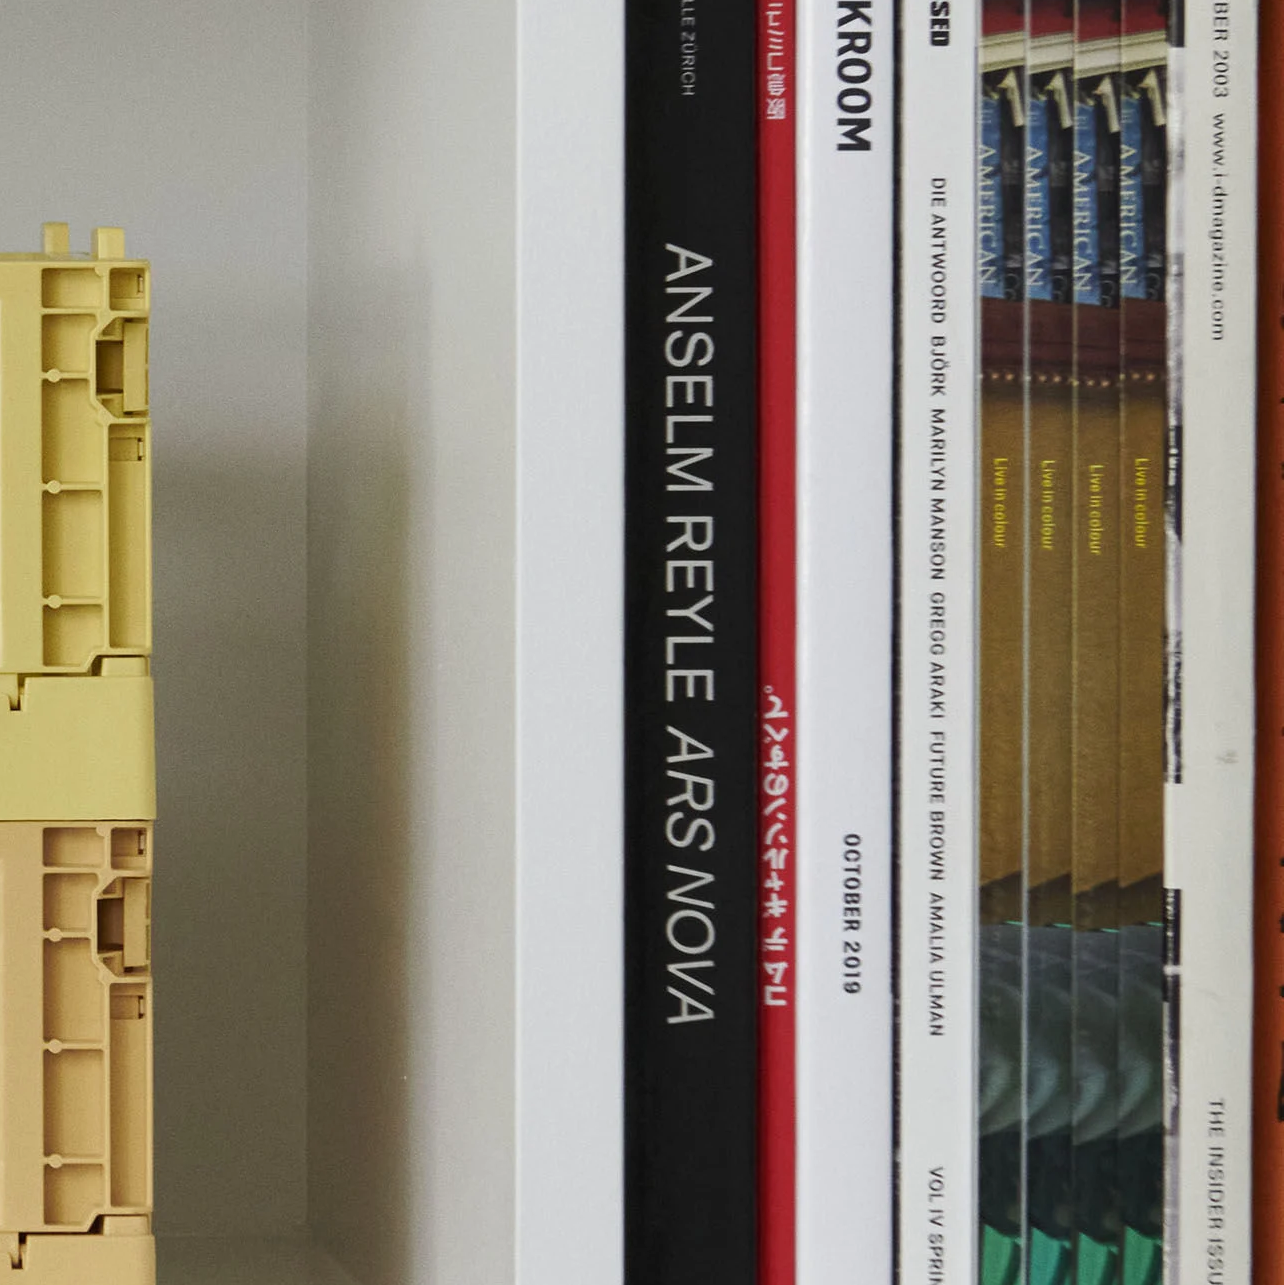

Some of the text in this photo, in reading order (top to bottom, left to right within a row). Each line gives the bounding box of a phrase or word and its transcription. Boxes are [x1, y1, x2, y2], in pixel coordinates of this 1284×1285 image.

[681, 32, 698, 96] ZÜRICH
[1213, 49, 1229, 99] 2003
[1208, 113, 1229, 341] www.i-dmagazine.com
[664, 243, 716, 1024] ANSELM REYLE ARS NOVA
[930, 177, 950, 1037] DIE ANTWOORD BJÖRK MARILYN MANSON GREGG ARAKI FUTURE BROWN AMALIA ULMAN
[843, 834, 860, 994] OCTOBER 2019
[929, 1166, 944, 1202] VOL
[929, 1209, 944, 1227] IV
